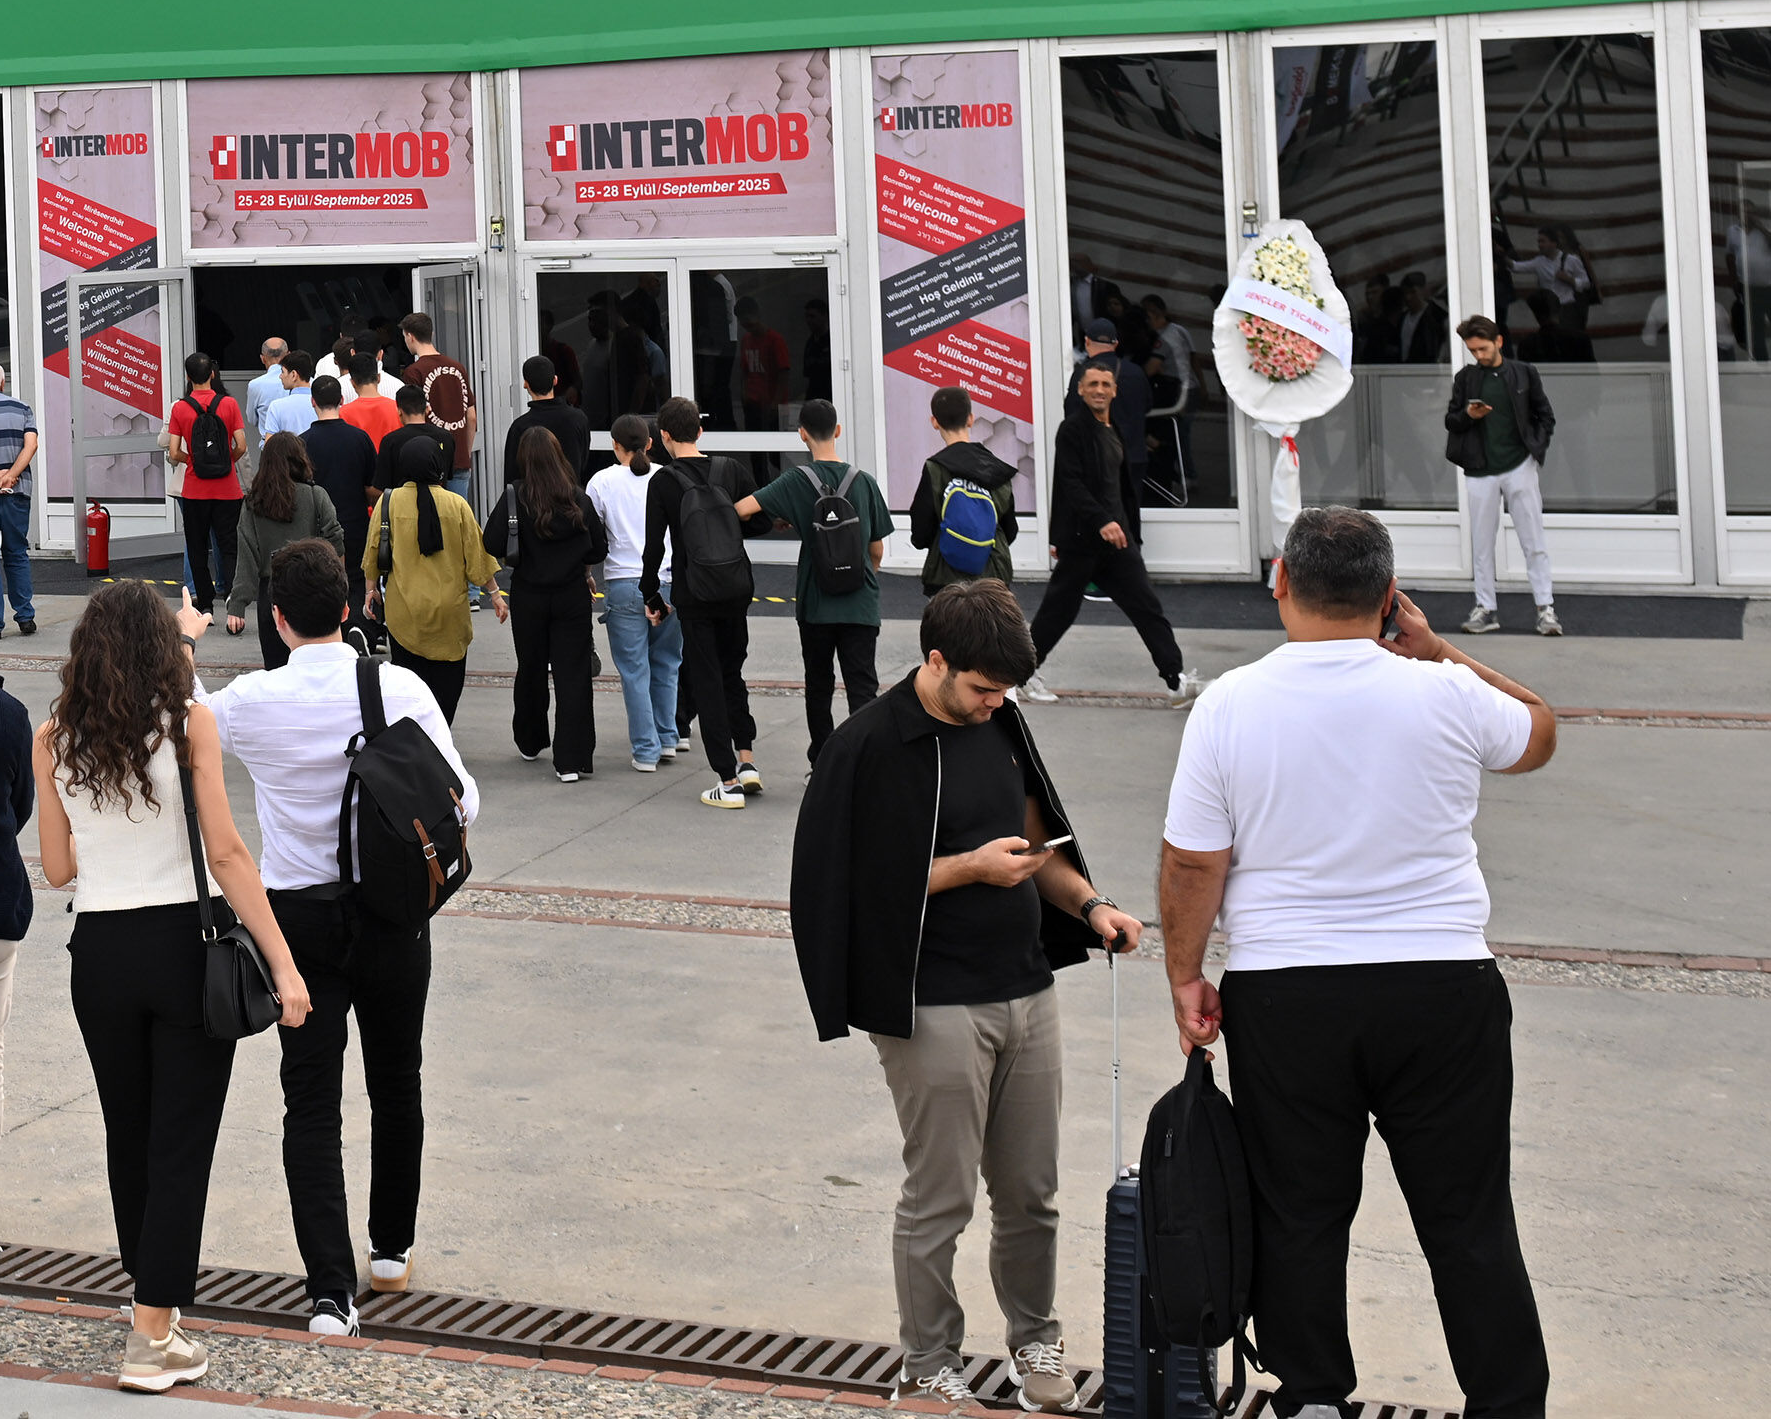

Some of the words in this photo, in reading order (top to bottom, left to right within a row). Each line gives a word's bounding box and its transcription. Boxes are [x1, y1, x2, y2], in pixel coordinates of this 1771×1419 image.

[896, 102, 1014, 132] INTERMOB
[54, 133, 148, 157] INTERMOB
[240, 131, 450, 180] INTERMOB
[579, 112, 811, 171] INTERMOB
[383, 193, 413, 205] 2025
[737, 178, 771, 192] 2025
[903, 195, 959, 226] Welcome
[42, 223, 55, 235] Bem
[59, 215, 104, 243] Welcome
[919, 290, 941, 305] Hoş
[941, 271, 985, 296] Geldiniz
[947, 333, 978, 351] Croeso
[87, 348, 139, 377] Willkommen
[937, 343, 1003, 377] Willkommen
[104, 380, 131, 397] Welkom
[959, 379, 993, 399] Welkom
